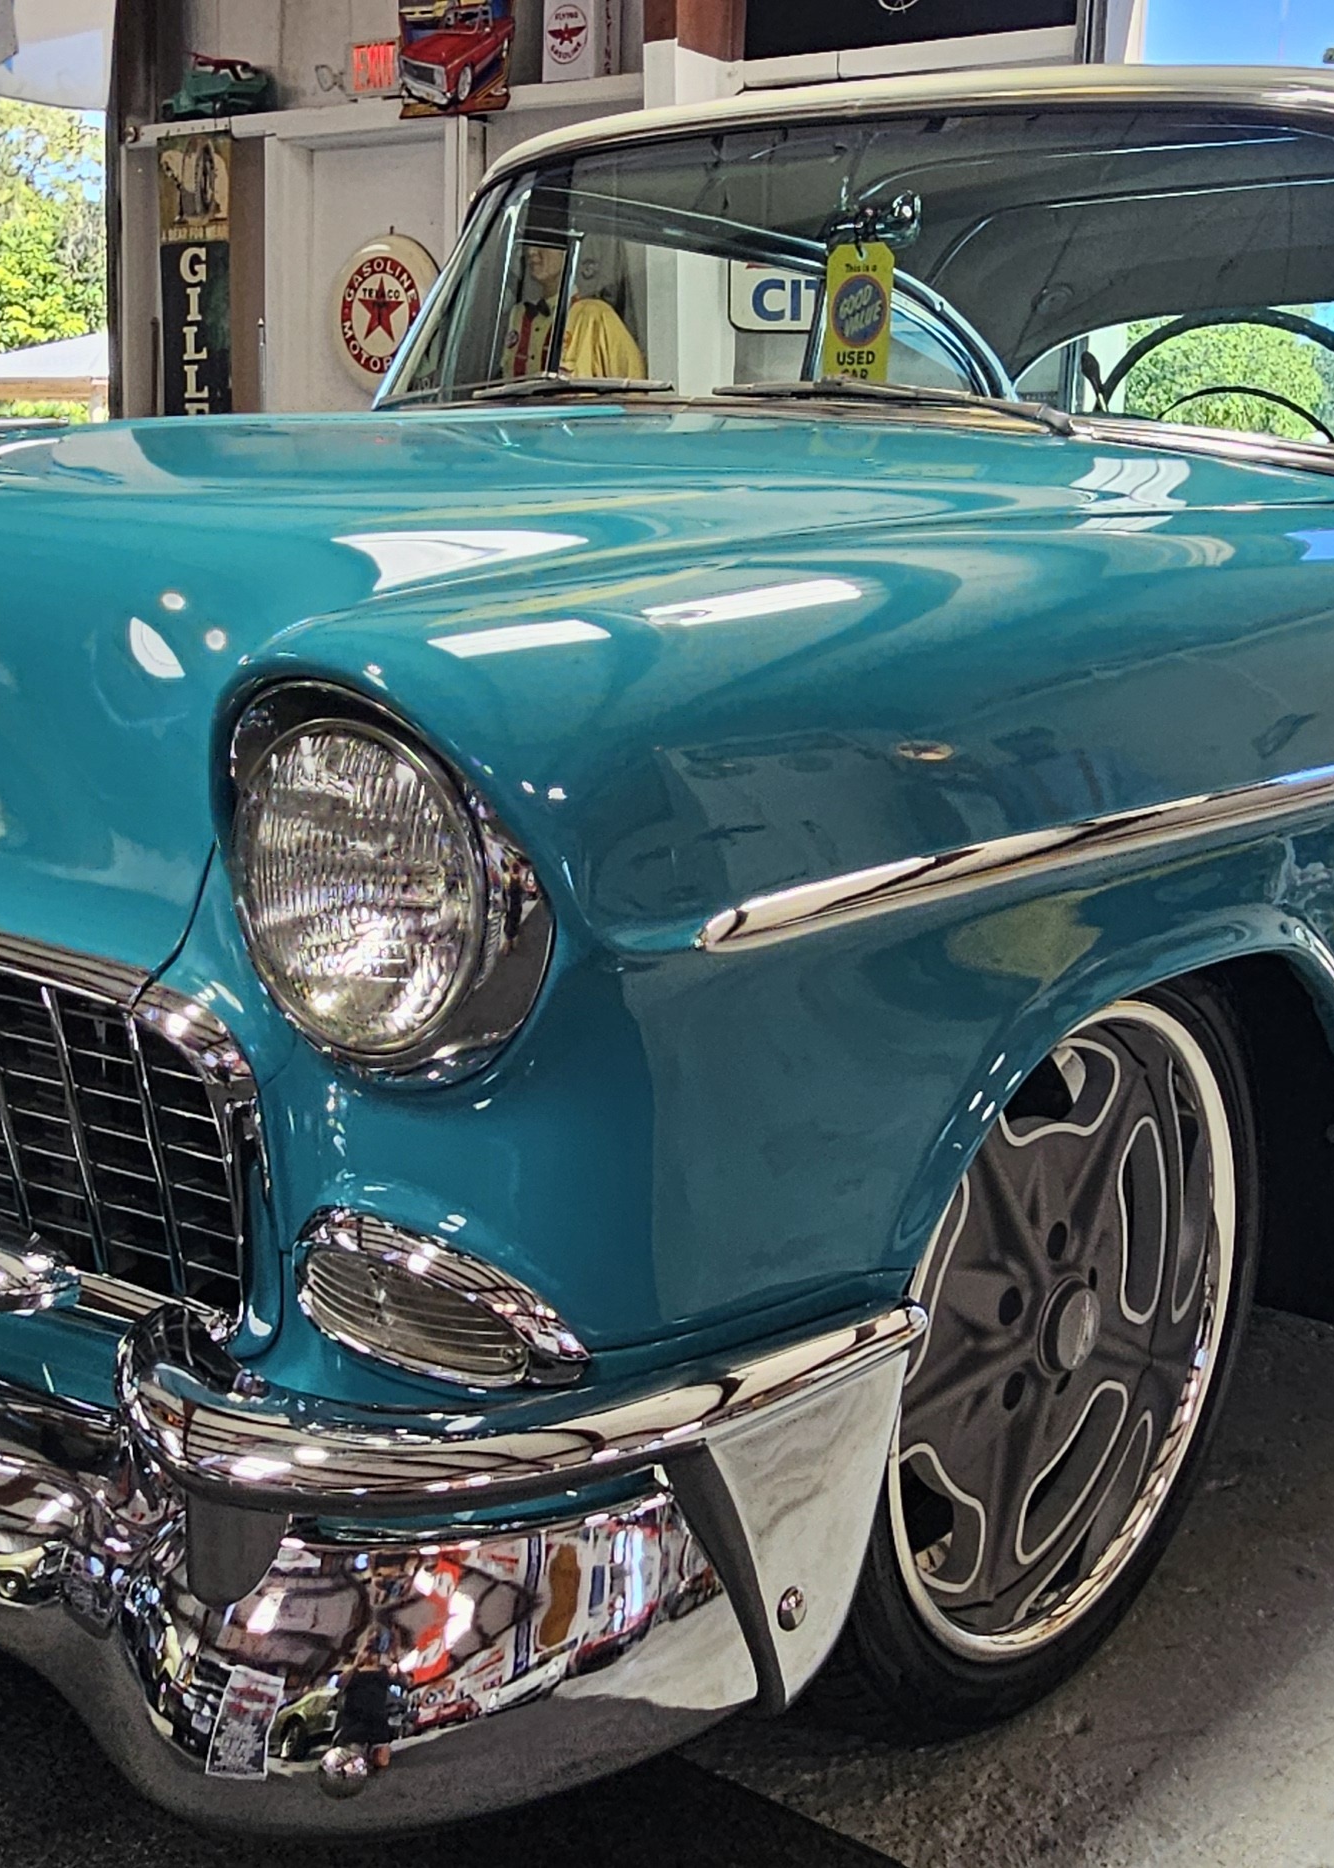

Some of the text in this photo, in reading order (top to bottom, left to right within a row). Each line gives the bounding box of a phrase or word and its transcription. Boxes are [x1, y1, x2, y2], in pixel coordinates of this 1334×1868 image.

[604, 0, 612, 75] LYING
[344, 258, 417, 304] GASOLINE
[845, 263, 860, 273] This
[362, 287, 400, 300] TEXACO
[839, 284, 873, 321] GOOD
[843, 299, 883, 338] VALUE
[836, 350, 876, 366] USED
